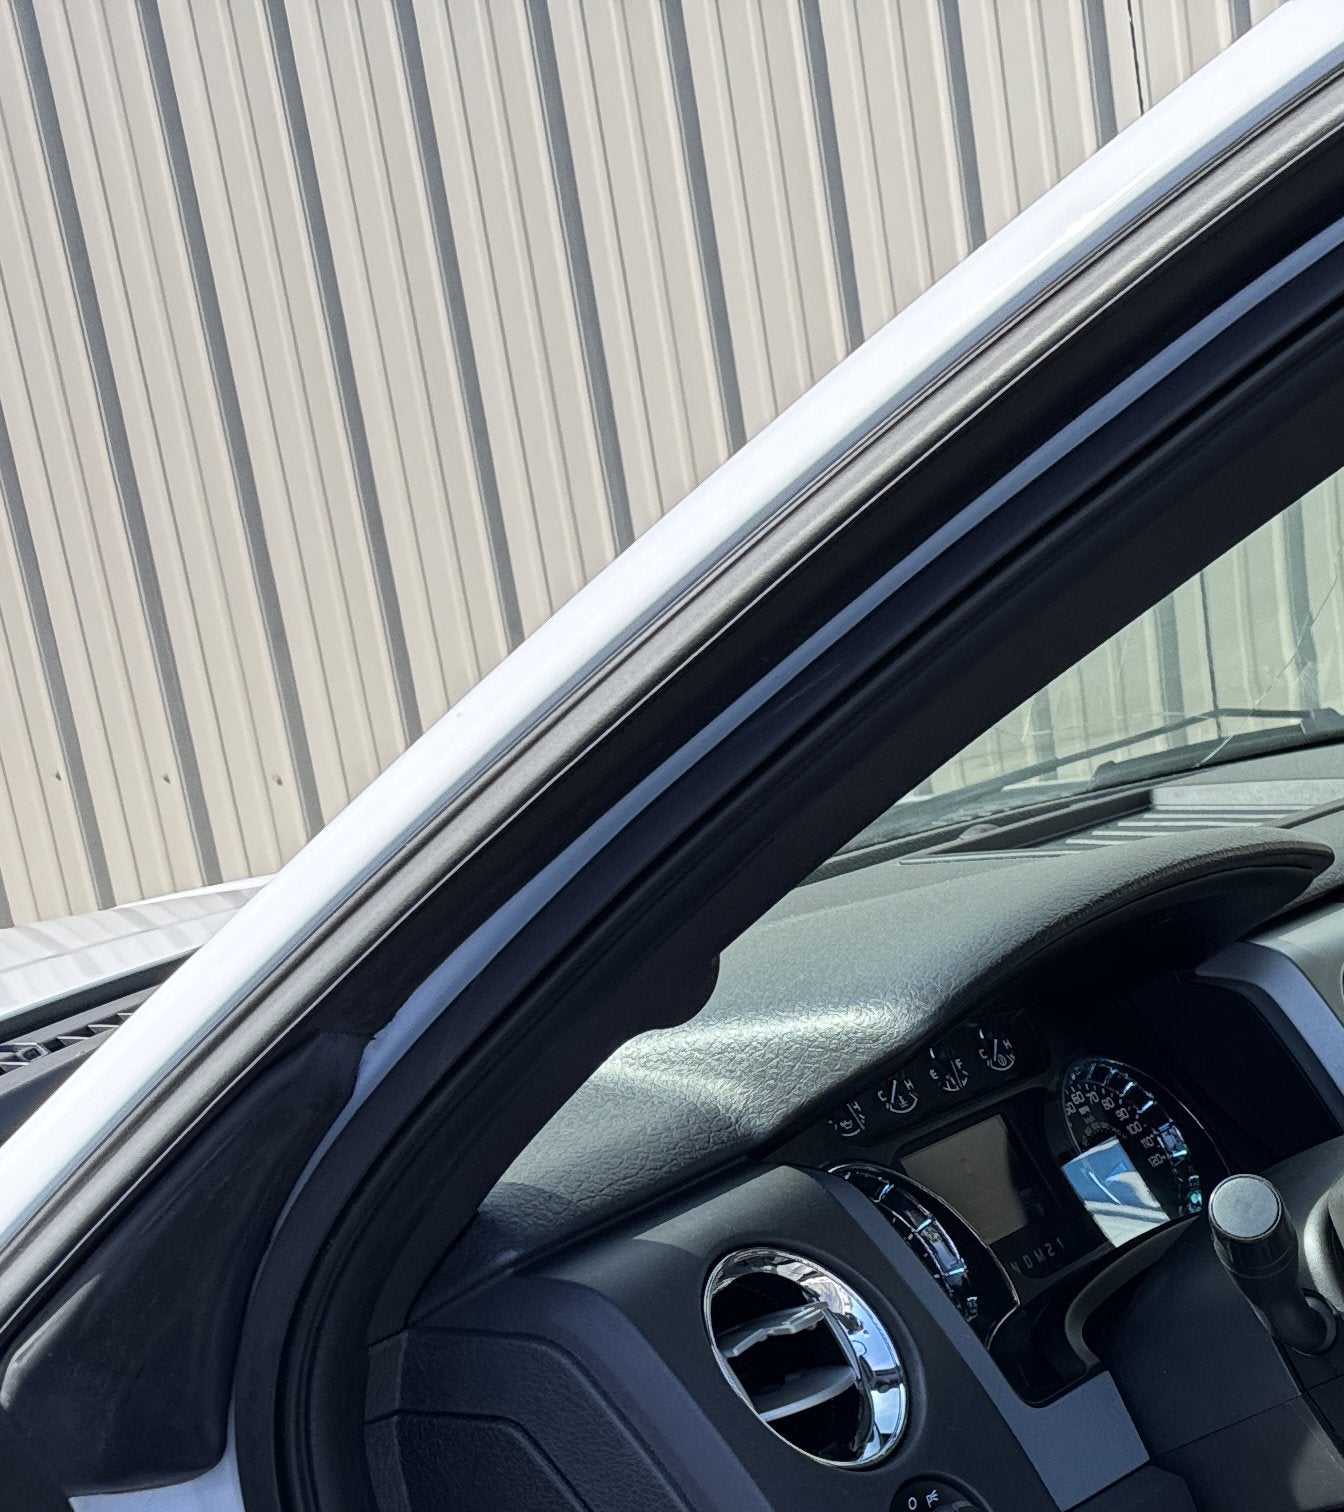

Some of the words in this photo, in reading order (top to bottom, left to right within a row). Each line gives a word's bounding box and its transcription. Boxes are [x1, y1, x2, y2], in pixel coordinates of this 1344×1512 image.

[903, 1079, 915, 1091] H
[1071, 1091, 1085, 1105] 60
[1086, 1091, 1099, 1105] 70
[1115, 1107, 1130, 1121] 90
[1126, 1121, 1142, 1135] 100
